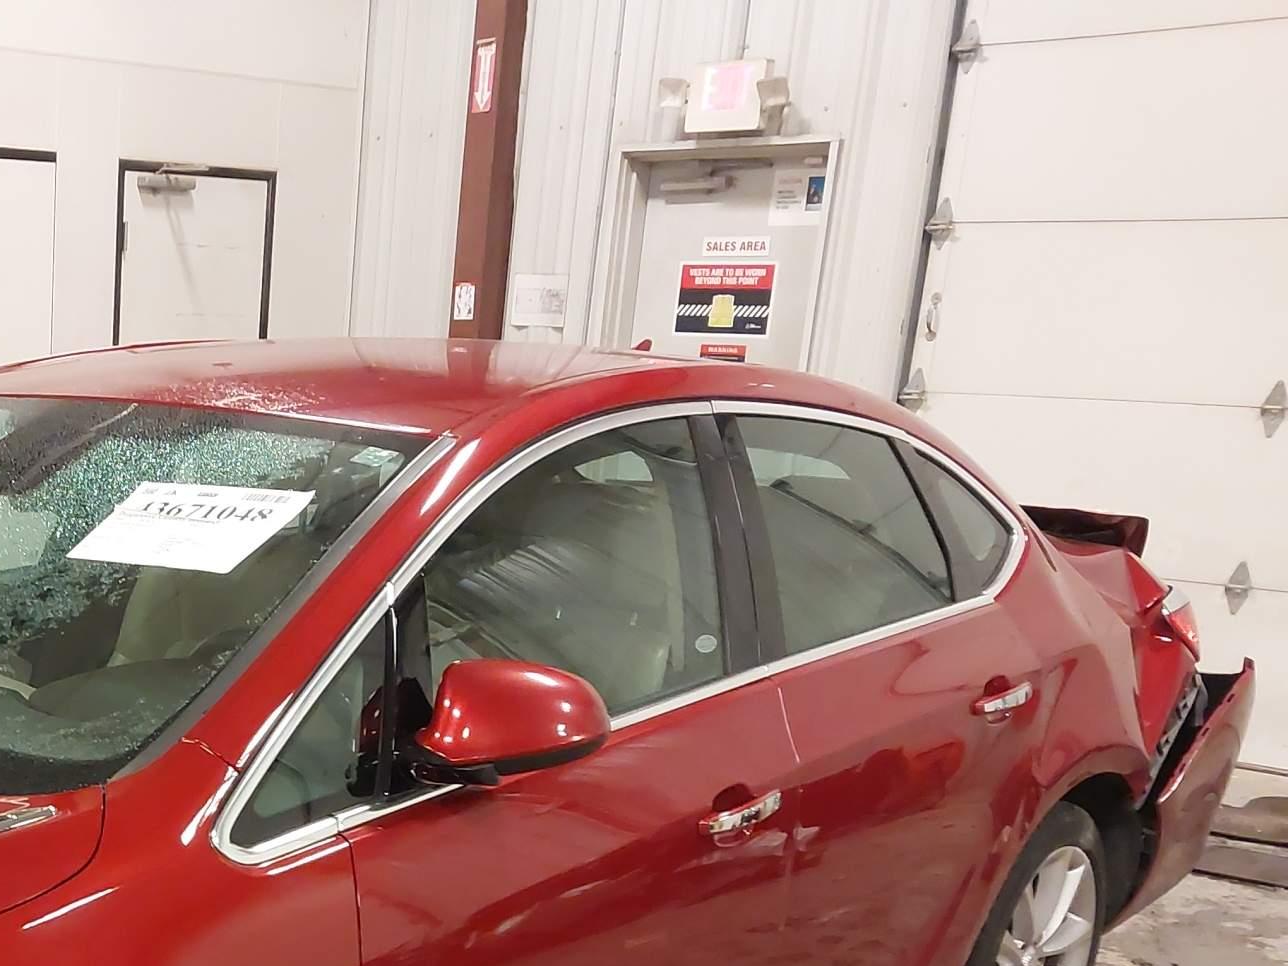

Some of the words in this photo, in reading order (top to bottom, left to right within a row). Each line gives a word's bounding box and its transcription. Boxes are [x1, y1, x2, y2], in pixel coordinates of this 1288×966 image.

[706, 241, 737, 251] SALES
[739, 241, 767, 251] AREA
[711, 268, 724, 276] ARE
[725, 268, 734, 276] TO
[735, 268, 744, 276] BE
[695, 277, 721, 285] BEYOND
[722, 277, 737, 285] THIS
[738, 277, 759, 285] POINT
